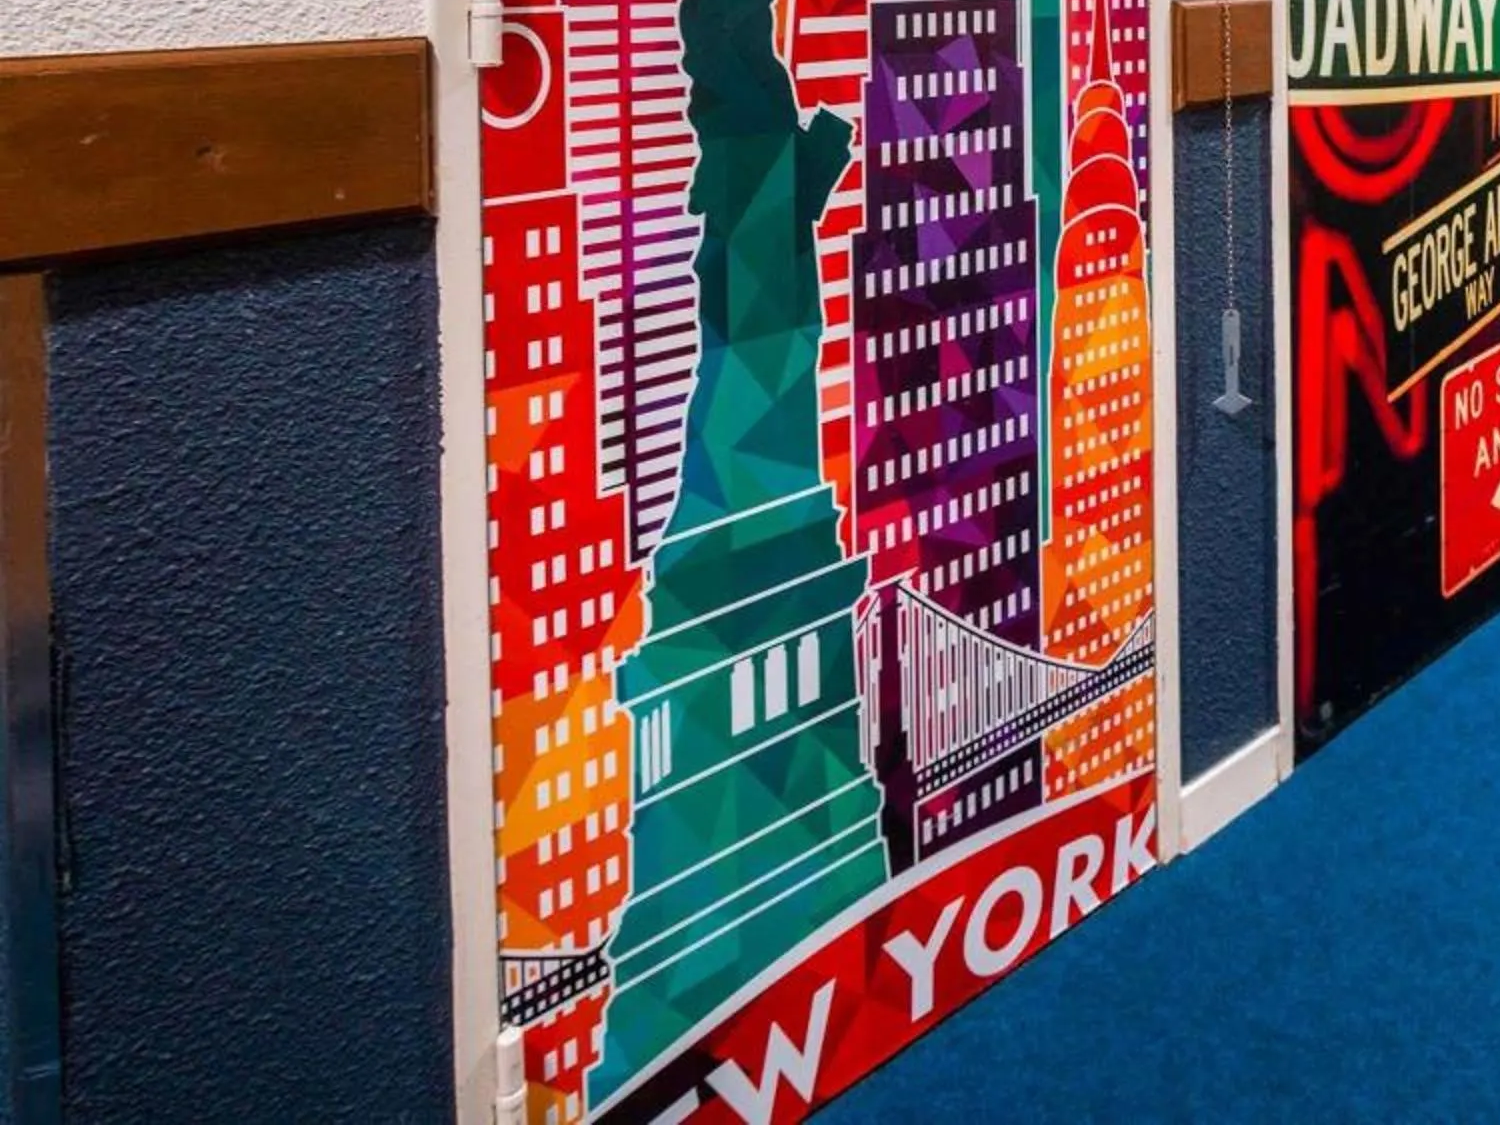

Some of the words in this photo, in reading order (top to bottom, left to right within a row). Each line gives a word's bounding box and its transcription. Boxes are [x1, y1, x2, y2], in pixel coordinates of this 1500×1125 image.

[1392, 202, 1478, 332] GEORGE
[1464, 265, 1495, 321] WAY
[1454, 379, 1484, 430] NO
[881, 801, 1159, 1024] YORK
